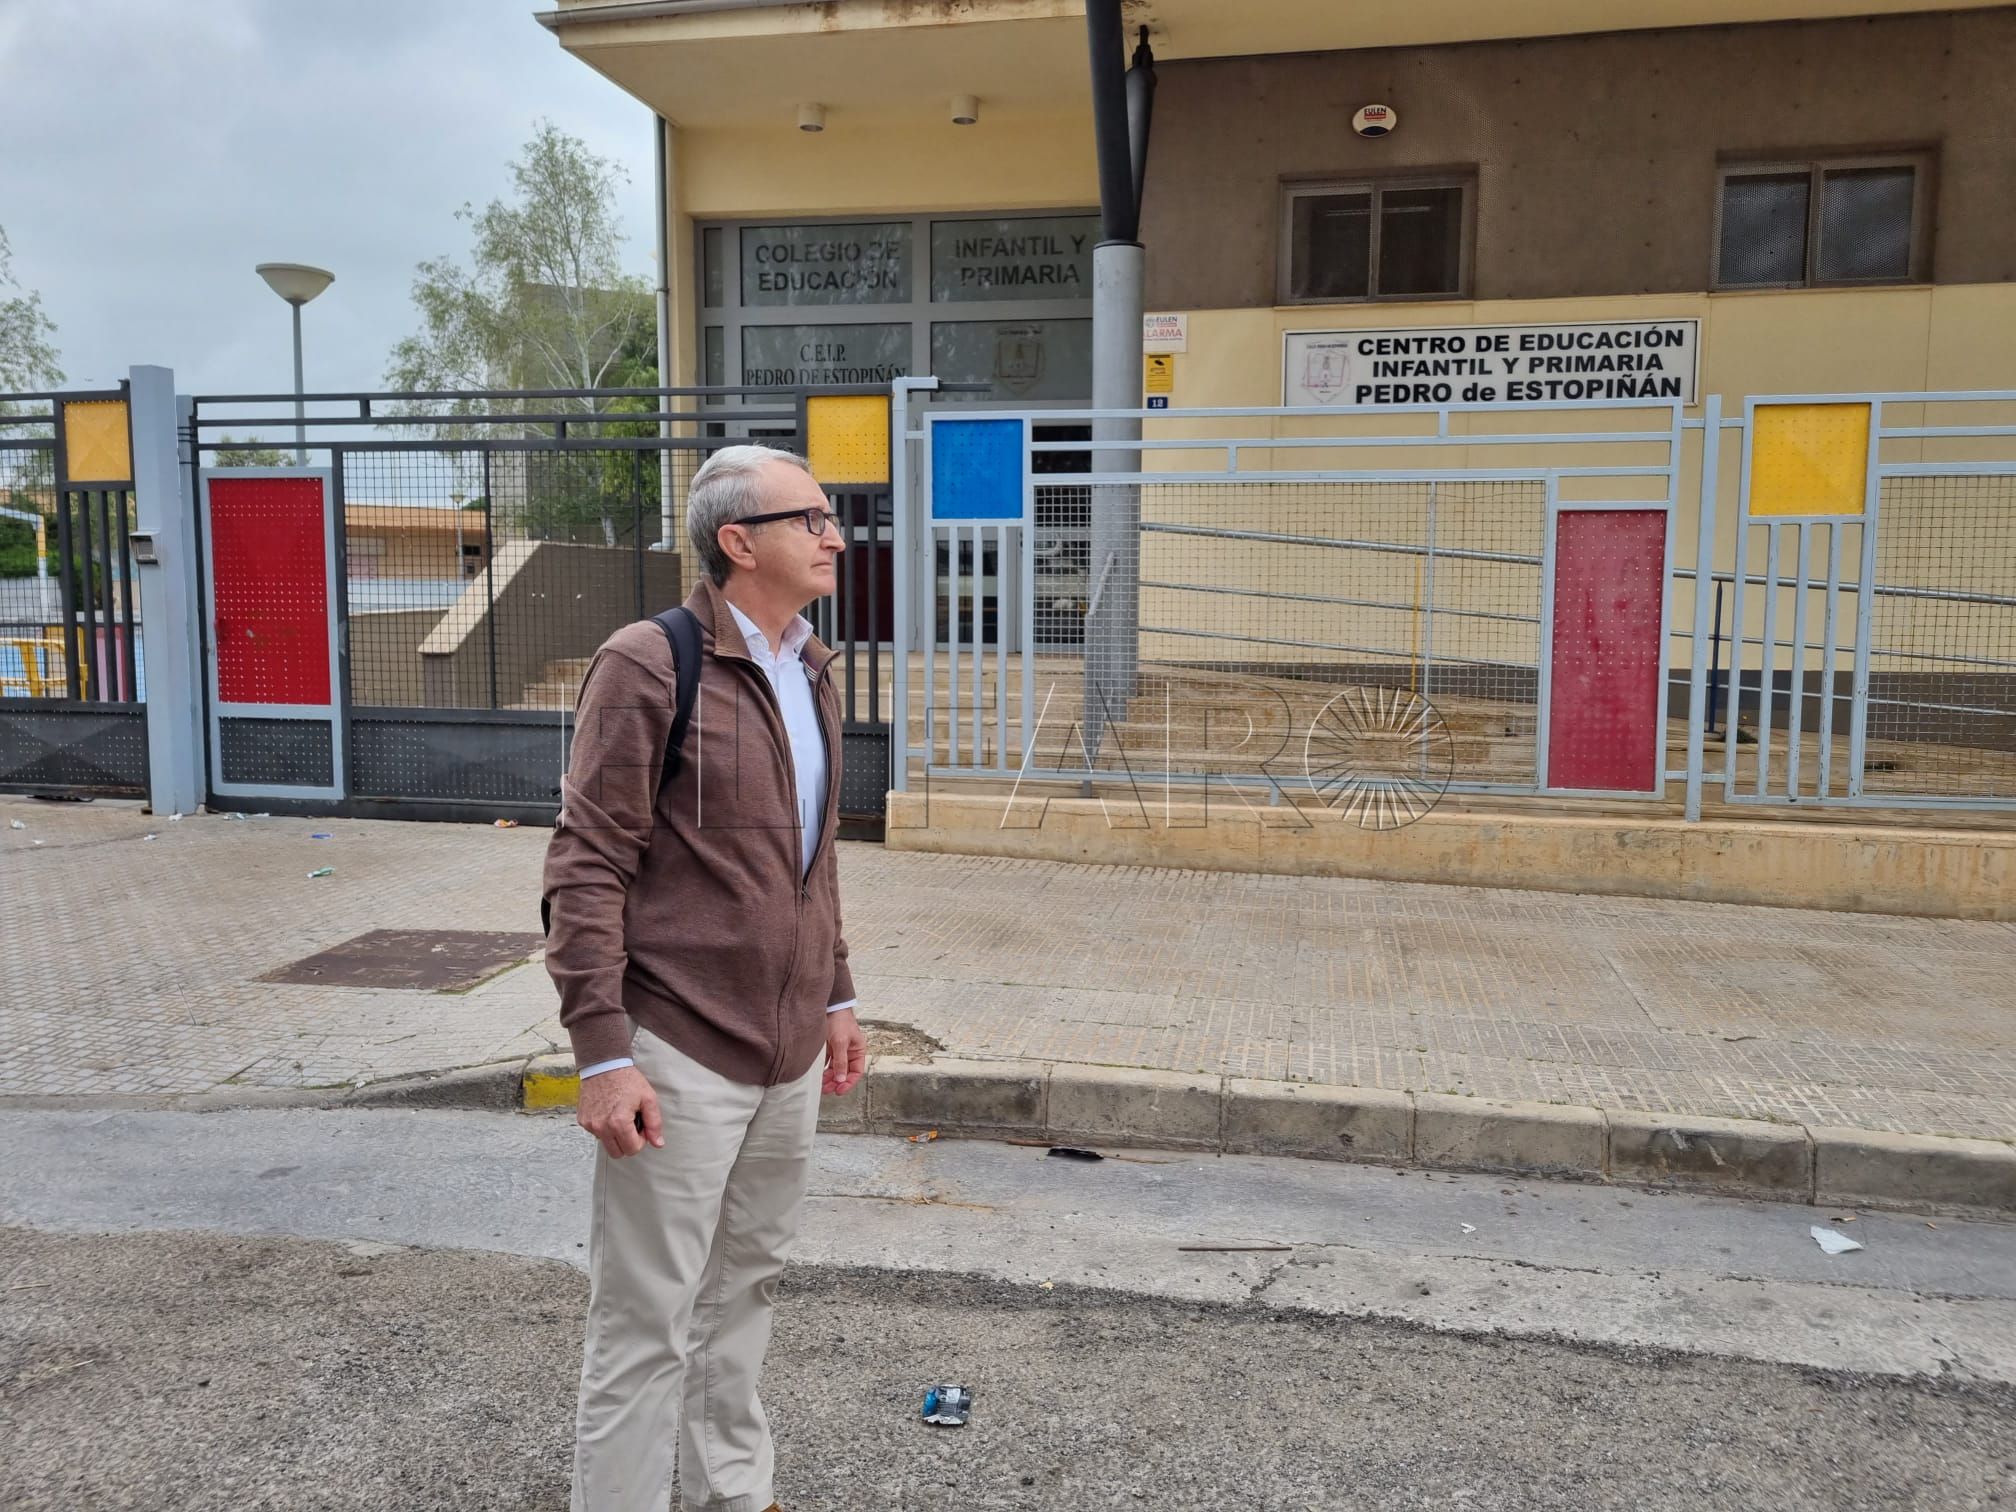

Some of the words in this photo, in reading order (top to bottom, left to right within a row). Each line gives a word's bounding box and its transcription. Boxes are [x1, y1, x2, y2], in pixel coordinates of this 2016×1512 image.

[756, 242, 861, 264] COLEGIO
[956, 236, 1064, 258] INFANTIL
[1070, 234, 1087, 255] Y
[961, 263, 1080, 287] PRIMARIA
[1144, 328, 1183, 338] LARMA
[1358, 336, 1466, 356] CENTRO
[1475, 334, 1510, 353] DE
[1519, 325, 1684, 351] EDUCACIÓN
[800, 343, 846, 362] C.E.I.P.
[747, 368, 795, 386] PEDRO
[1373, 357, 1492, 377] INFANTIL
[1502, 357, 1520, 374] Y
[1529, 353, 1664, 374] PRIMARIA
[1355, 382, 1452, 404] PEDRO
[1462, 382, 1496, 402] de
[1506, 373, 1681, 401] ESTOPIÑÁN
